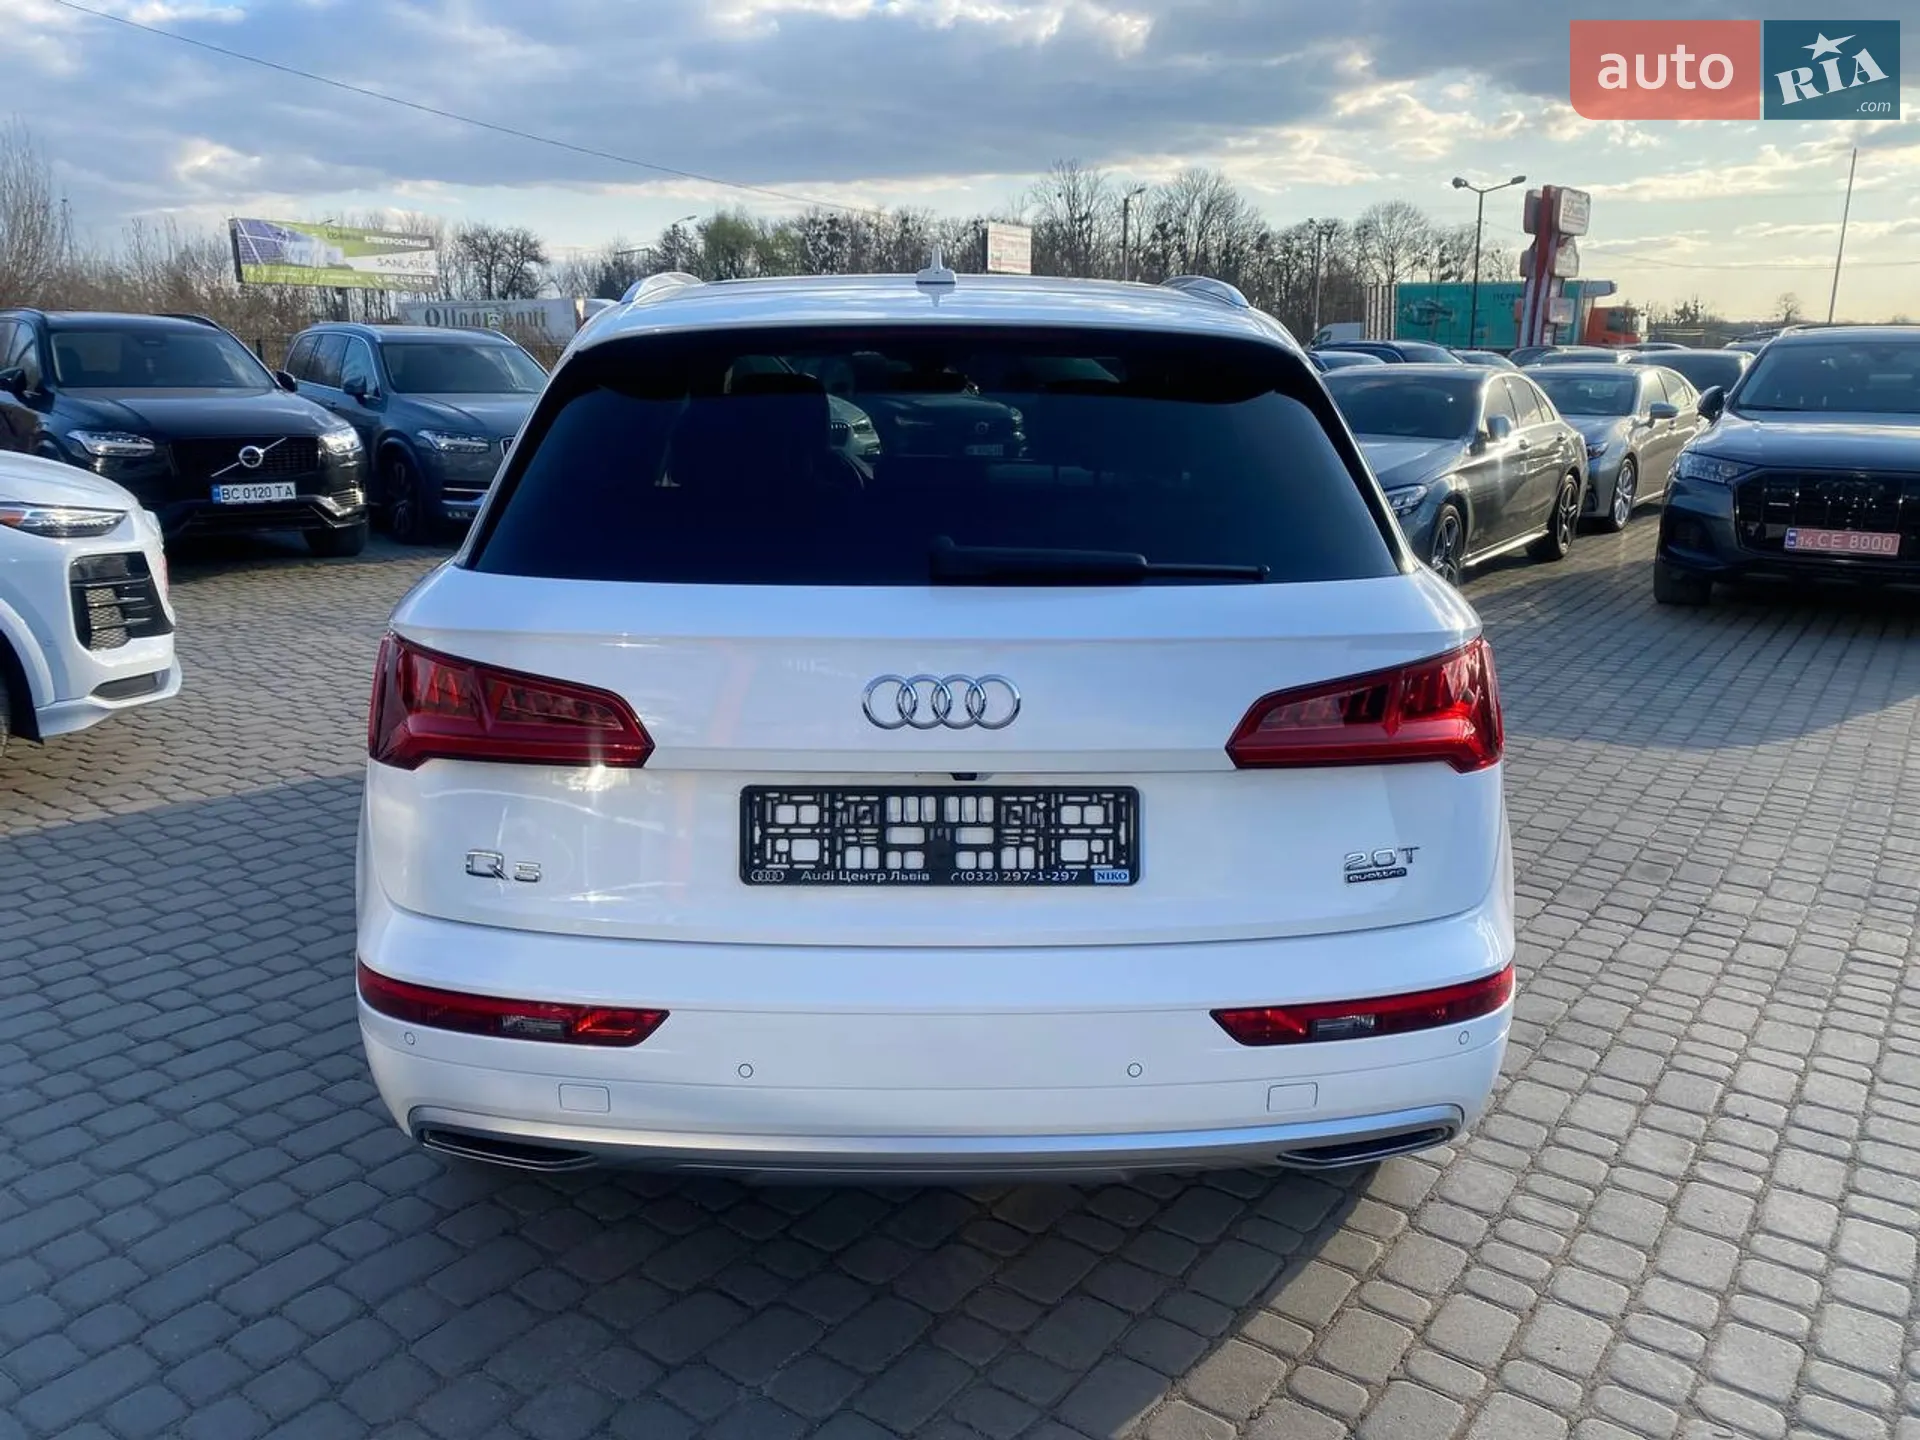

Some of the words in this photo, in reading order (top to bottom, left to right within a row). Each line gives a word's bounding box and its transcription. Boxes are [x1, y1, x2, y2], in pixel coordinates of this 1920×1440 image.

[222, 487, 240, 500] BC
[243, 486, 272, 499] 0120
[275, 485, 294, 497] TA
[465, 848, 542, 883] Q5
[801, 870, 834, 881] Audi
[838, 871, 886, 883] Центр
[890, 870, 930, 882] Львів
[1003, 871, 1079, 882] 297-1-297
[1096, 870, 1128, 881] NIKO
